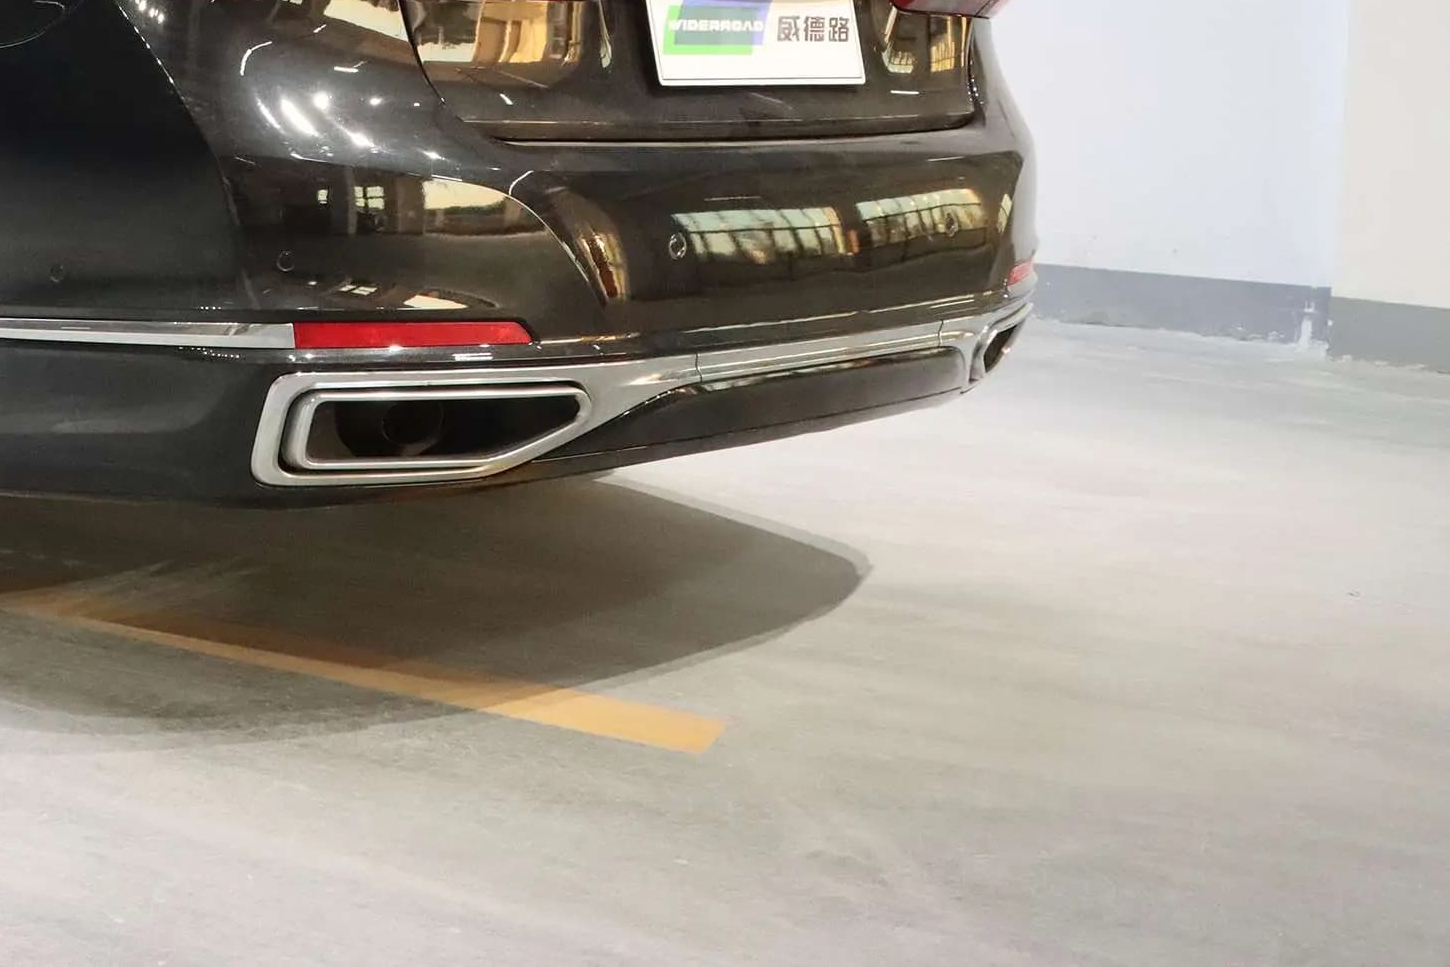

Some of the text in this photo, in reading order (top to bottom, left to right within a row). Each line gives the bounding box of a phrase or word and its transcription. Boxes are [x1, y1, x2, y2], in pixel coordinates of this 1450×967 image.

[668, 19, 764, 32] WIDERROAD
[777, 15, 849, 43] 威德路
